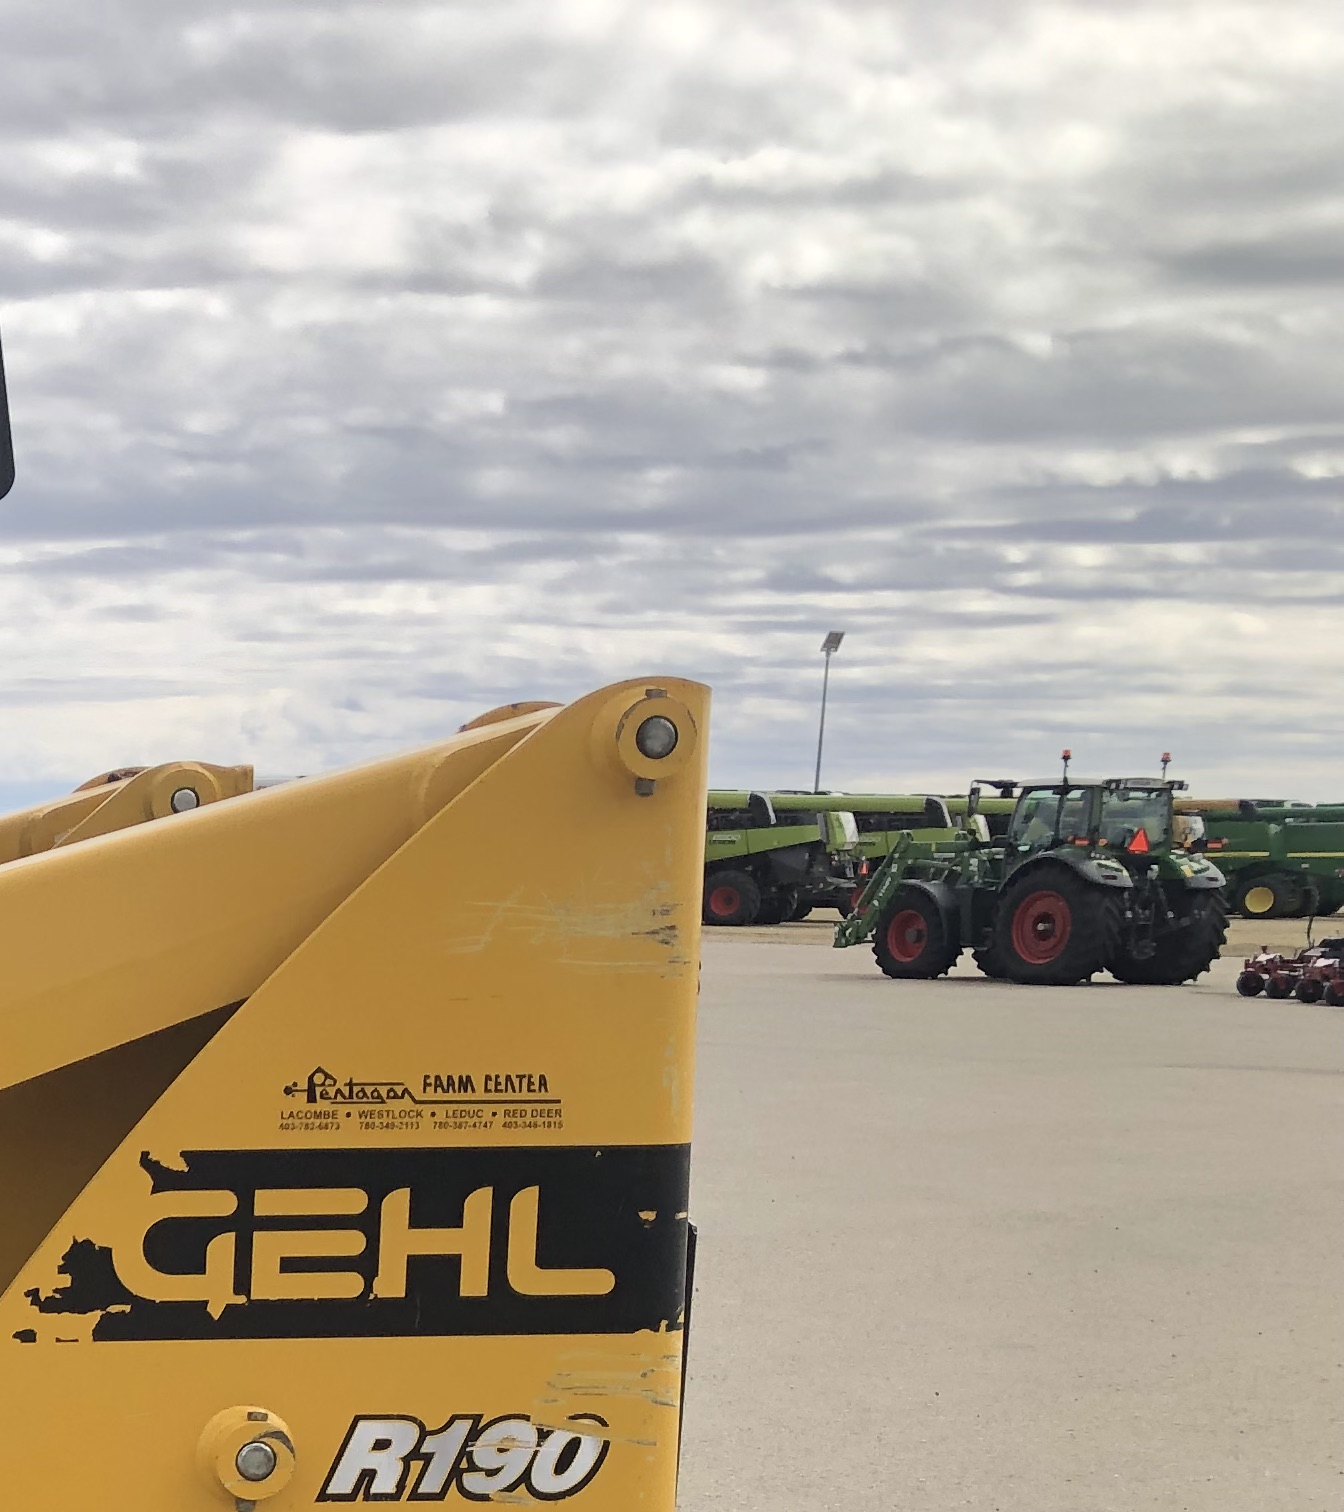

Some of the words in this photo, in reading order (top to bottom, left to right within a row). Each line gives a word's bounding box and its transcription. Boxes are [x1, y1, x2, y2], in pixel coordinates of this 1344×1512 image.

[280, 1110, 339, 1120] LACOMBE
[357, 1109, 424, 1119] WESTLOCK
[445, 1109, 484, 1119] LEDUC
[503, 1108, 528, 1119] RED
[530, 1108, 562, 1119] DEER
[112, 1185, 615, 1302] GEHL
[315, 1413, 611, 1502] R190
